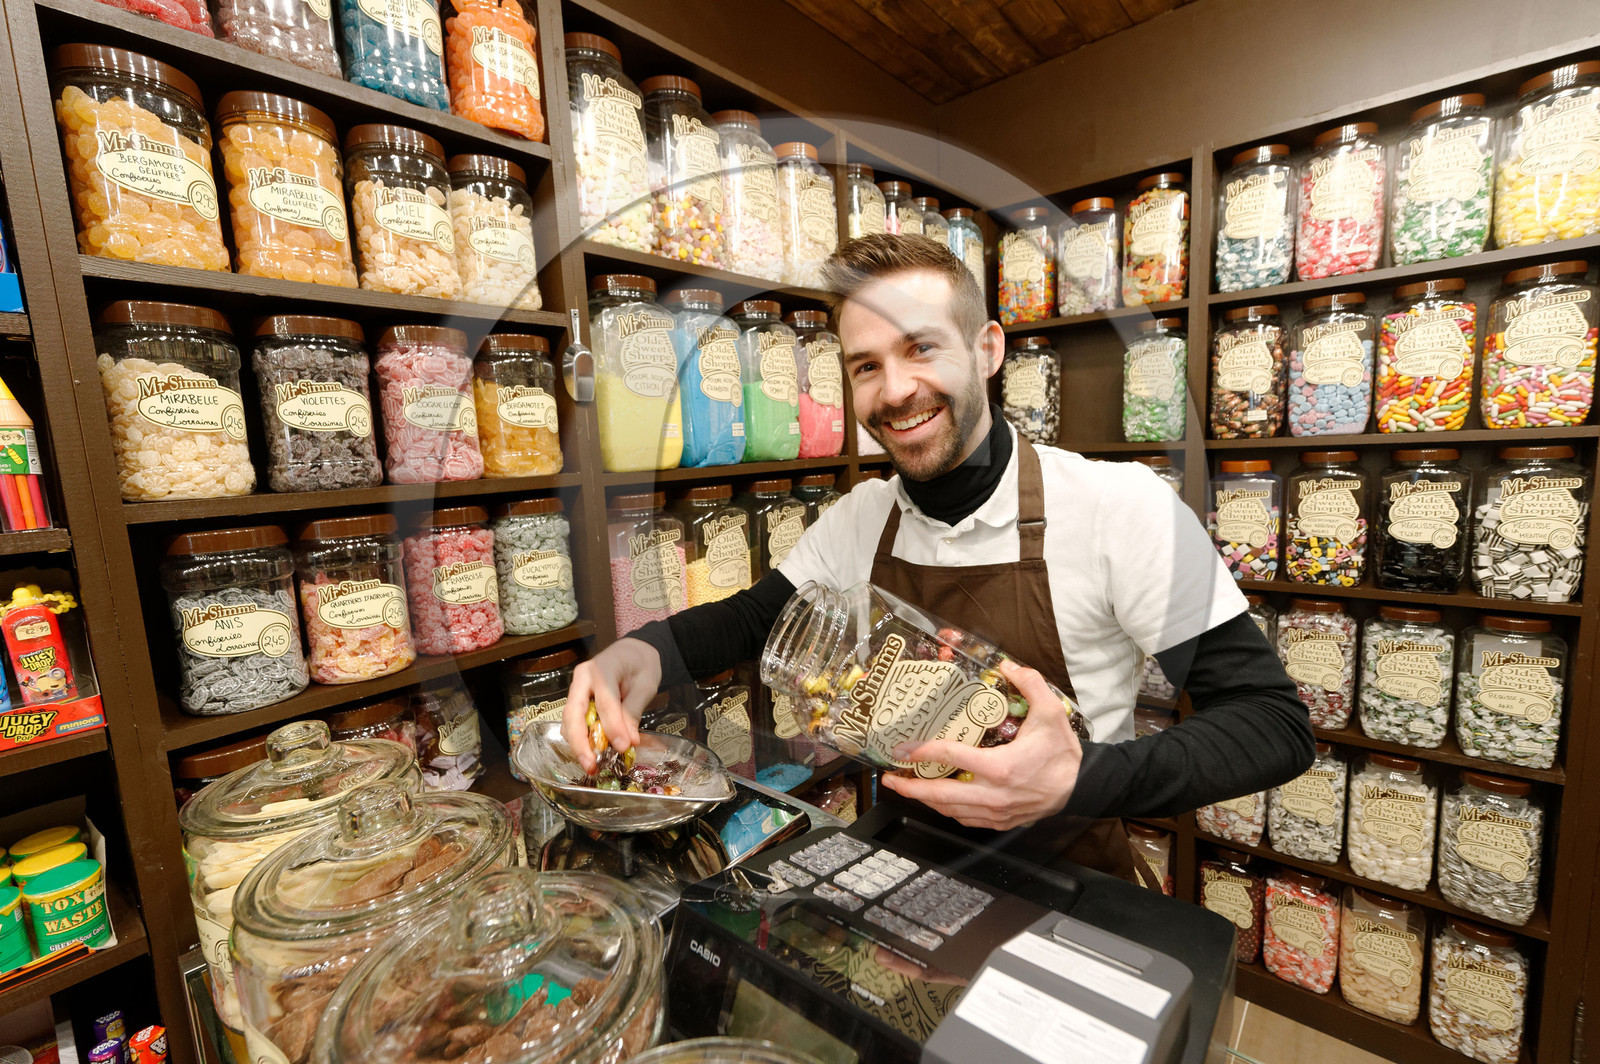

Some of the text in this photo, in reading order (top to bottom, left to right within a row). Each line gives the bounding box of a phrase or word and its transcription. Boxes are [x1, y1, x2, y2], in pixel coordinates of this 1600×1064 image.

[582, 73, 641, 109] Mr Simms
[672, 114, 690, 140] Mr
[98, 131, 184, 159] Mr Simms
[118, 153, 186, 174] BERGAMOTES
[250, 170, 318, 190] Mr Simms
[270, 186, 324, 204] MIRABELLES
[375, 189, 394, 208] Mr
[395, 204, 424, 219] MIEL
[469, 218, 485, 231] Mr
[493, 230, 510, 241] PIN
[1506, 291, 1590, 321] Mr Simms
[618, 313, 673, 339] Mr Simms
[636, 335, 664, 345] Olde
[697, 327, 712, 349] Mr
[758, 331, 772, 353] Mr
[1302, 328, 1323, 347] Mr
[628, 351, 672, 363] Shoppe
[633, 344, 667, 353] Sweet
[137, 375, 217, 399] Mr Simms
[276, 381, 341, 402] Mr Simms
[403, 386, 457, 404] Mr Simms
[498, 386, 543, 404] Mr Simms
[160, 393, 219, 405] MIRABELLE
[300, 397, 346, 406] VIOLETTES
[148, 406, 200, 418] Confiseries
[283, 409, 327, 419] Confiseries
[1299, 478, 1360, 498] Mr Simms
[1390, 480, 1460, 500] Mr Simms
[1501, 476, 1582, 498] Mr Simms
[1216, 488, 1269, 507] Mr Simms
[767, 505, 806, 532] Mr Simms
[703, 514, 746, 545] Mr Simms
[717, 534, 740, 543] Olde
[629, 528, 680, 559] Mr Simms
[715, 542, 742, 550] Sweet
[513, 551, 558, 570] Mr Simms
[645, 550, 671, 560] Olde
[712, 547, 747, 560] Shoppe
[522, 563, 559, 574] EUCALYPTUS
[638, 564, 679, 578] Shoppe
[642, 558, 674, 568] Sweet
[433, 561, 483, 585] Mr Simms
[446, 572, 483, 585] FRAMBOISE
[318, 580, 380, 606] Mr Simms
[183, 603, 257, 630] Mr Simms
[214, 616, 244, 631] ANIS
[189, 633, 242, 648] Confiseries
[264, 634, 286, 649] 2,45
[1288, 629, 1346, 643] Mr Simms
[216, 641, 260, 652] Lorraines
[1378, 640, 1444, 655] Mr Simms
[20, 650, 55, 668] JUICY
[29, 659, 55, 673] DROP
[1293, 651, 1336, 663] Shoppe
[1394, 654, 1427, 663] Olde
[1481, 651, 1560, 668] Mr Simms
[1385, 665, 1435, 677] Shoppe
[1495, 672, 1544, 684] Sweet
[1500, 667, 1540, 678] Olde
[832, 634, 903, 748] Mr Simms
[1488, 676, 1548, 691] Shoppe
[705, 690, 748, 729] Mr Simms
[877, 677, 914, 726] Olde
[884, 679, 931, 737] Sweet
[977, 697, 999, 722] 2,45
[0, 711, 58, 727] JUICY
[523, 706, 539, 721] Mr
[890, 675, 945, 751] Shoppe
[5, 722, 42, 739] DROP
[59, 715, 101, 731] minions
[1364, 785, 1425, 803] Mr Simms
[1460, 806, 1532, 830] Mr Simms
[1473, 827, 1516, 844] Sweet
[1476, 822, 1513, 837] Olde
[1465, 831, 1521, 851] Shoppe
[1204, 868, 1252, 886] Mr Simms
[1273, 892, 1326, 915] Mr Simms
[43, 898, 104, 934] WASTE
[79, 932, 93, 944] Sour
[1354, 918, 1417, 941] Mr Simms
[690, 939, 721, 968] CASIO
[1447, 953, 1517, 982] Mr Simms
